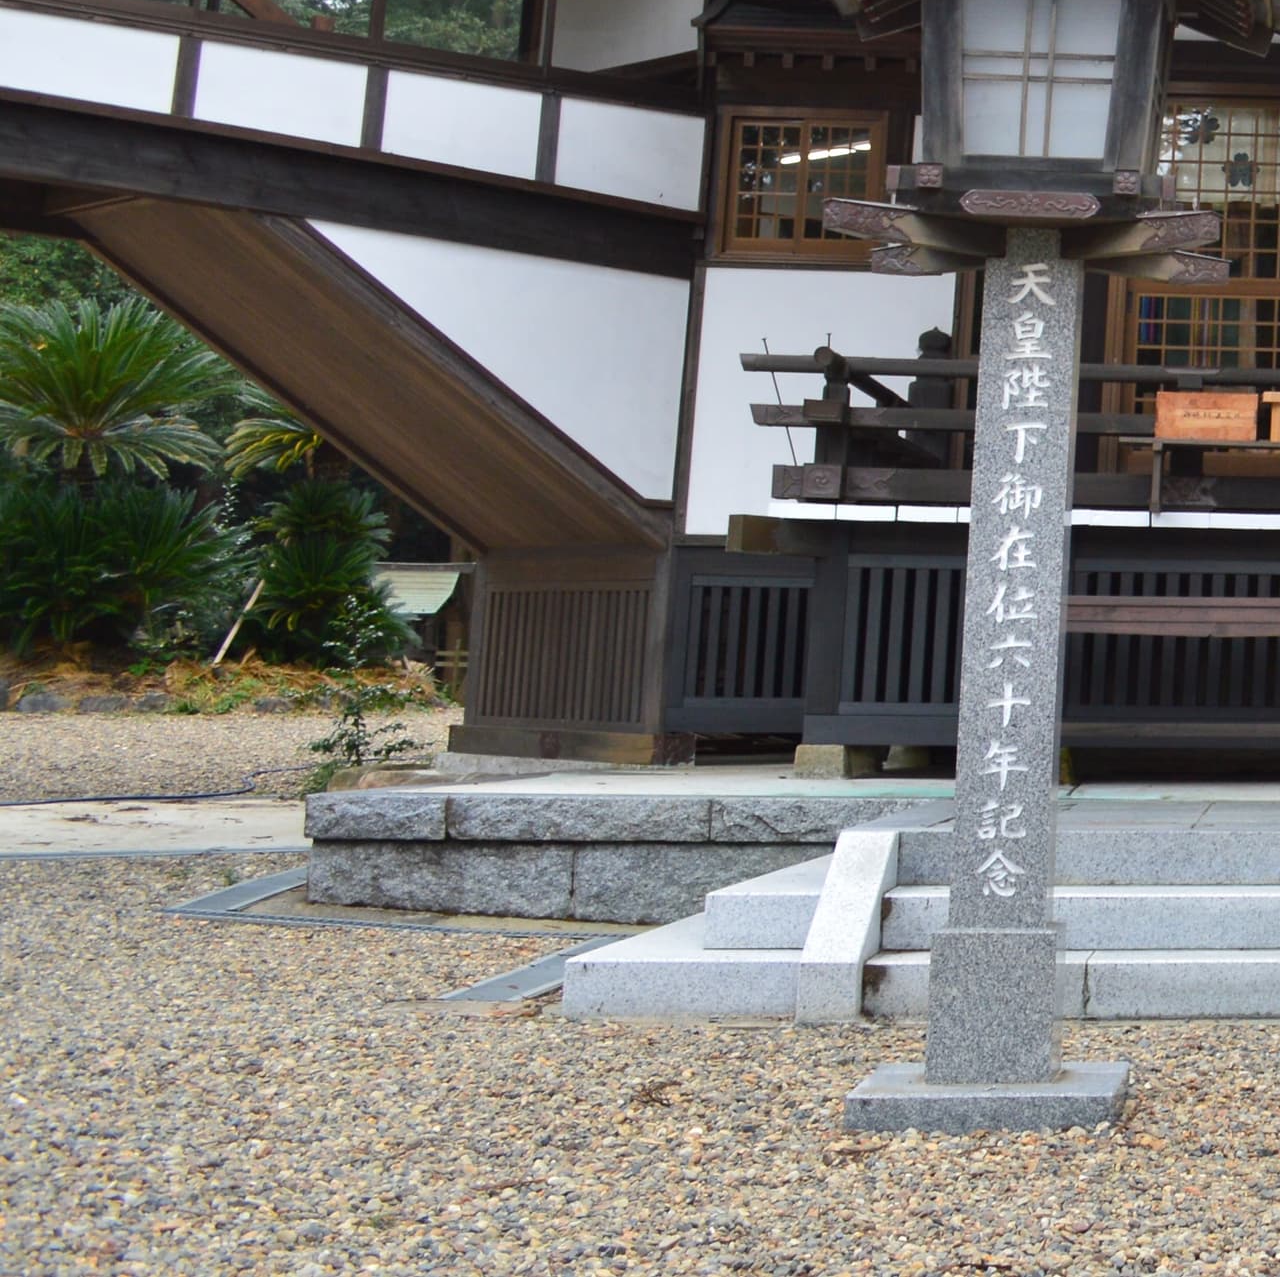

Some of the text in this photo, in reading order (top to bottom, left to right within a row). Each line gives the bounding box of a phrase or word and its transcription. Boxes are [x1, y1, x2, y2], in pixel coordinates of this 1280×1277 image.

[977, 265, 1056, 898] 天皇陛下御在位六十年記念
